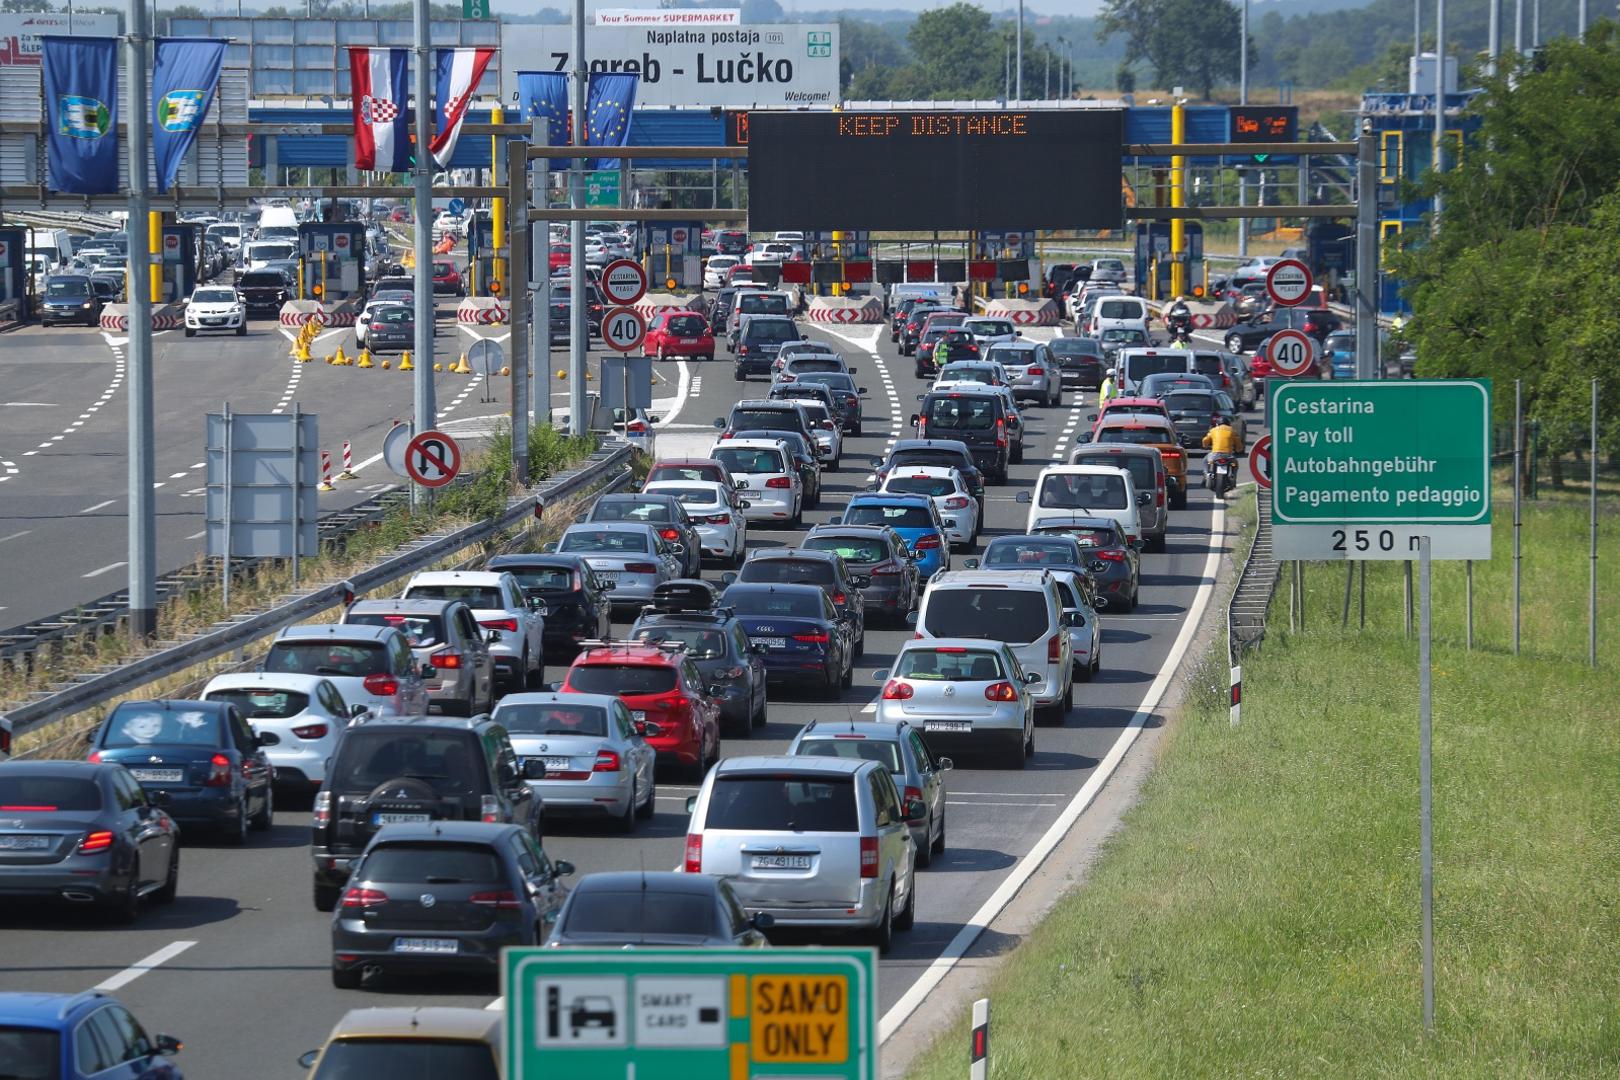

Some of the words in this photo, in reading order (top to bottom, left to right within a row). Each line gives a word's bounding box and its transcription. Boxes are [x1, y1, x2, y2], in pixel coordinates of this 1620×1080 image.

[601, 14, 621, 23] Your
[624, 14, 661, 22] Summer
[664, 13, 735, 22] SUPERMARKET
[647, 30, 705, 45] Naplatna
[712, 29, 759, 45] postaja
[550, 52, 661, 84] Zreb
[697, 51, 793, 84] Lučko
[784, 91, 831, 102] Welcome!
[839, 115, 900, 136] KEEP
[911, 114, 1028, 136] DISTANCE
[612, 319, 637, 340] 40
[1277, 343, 1303, 364] 40
[1284, 397, 1374, 415] Cestarina
[1284, 426, 1318, 447] Pay
[1325, 426, 1353, 443] toll
[1284, 456, 1437, 477] Autobahngebühr
[1285, 487, 1390, 507] Pagamento
[1396, 485, 1480, 507] pedaggio
[1332, 529, 1394, 551] 250
[640, 993, 693, 1008] SMART
[757, 981, 843, 1016] SAMO
[645, 1014, 689, 1029] CARD
[763, 1022, 837, 1056] ONLY
